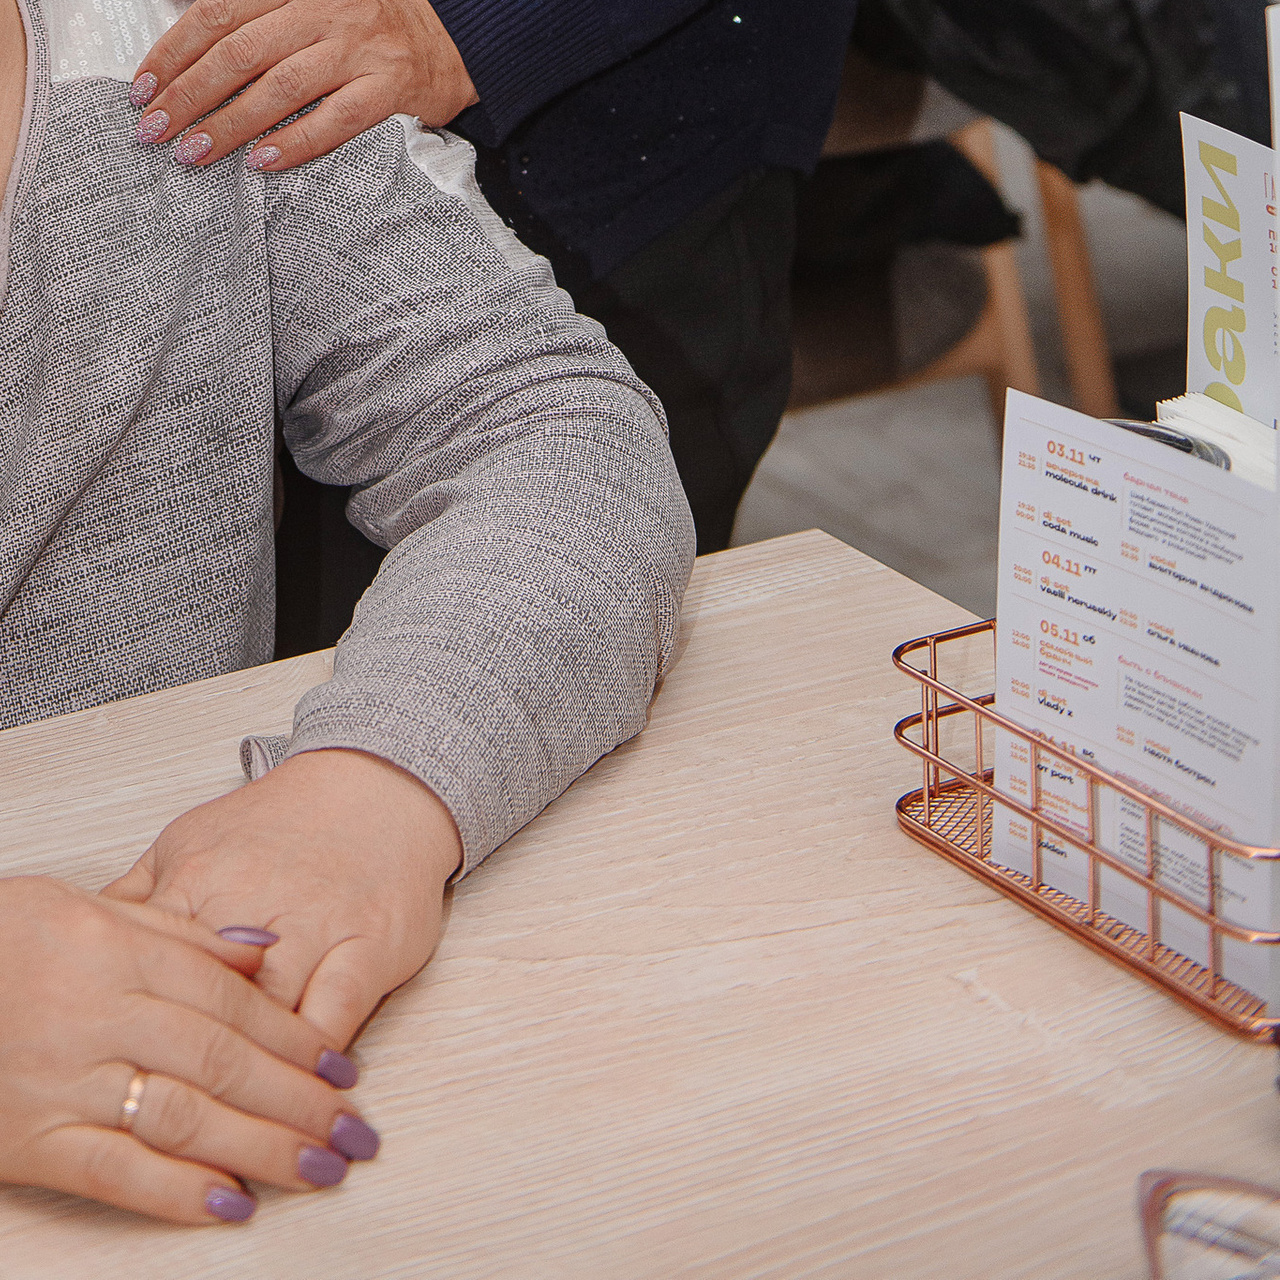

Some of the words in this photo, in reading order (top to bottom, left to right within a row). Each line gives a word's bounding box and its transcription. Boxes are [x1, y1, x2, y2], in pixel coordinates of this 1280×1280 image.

[1046, 439, 1086, 466] 03.11
[1088, 453, 1102, 463] чт
[1045, 469, 1089, 492] molecule
[1090, 486, 1118, 503] drink
[1042, 520, 1068, 535] coda
[1069, 529, 1099, 547] music
[1041, 550, 1083, 577] 04.11
[1084, 564, 1098, 575] пт
[1039, 619, 1081, 647] 05.11
[1082, 633, 1097, 645] сб
[1037, 695, 1066, 715] vlady
